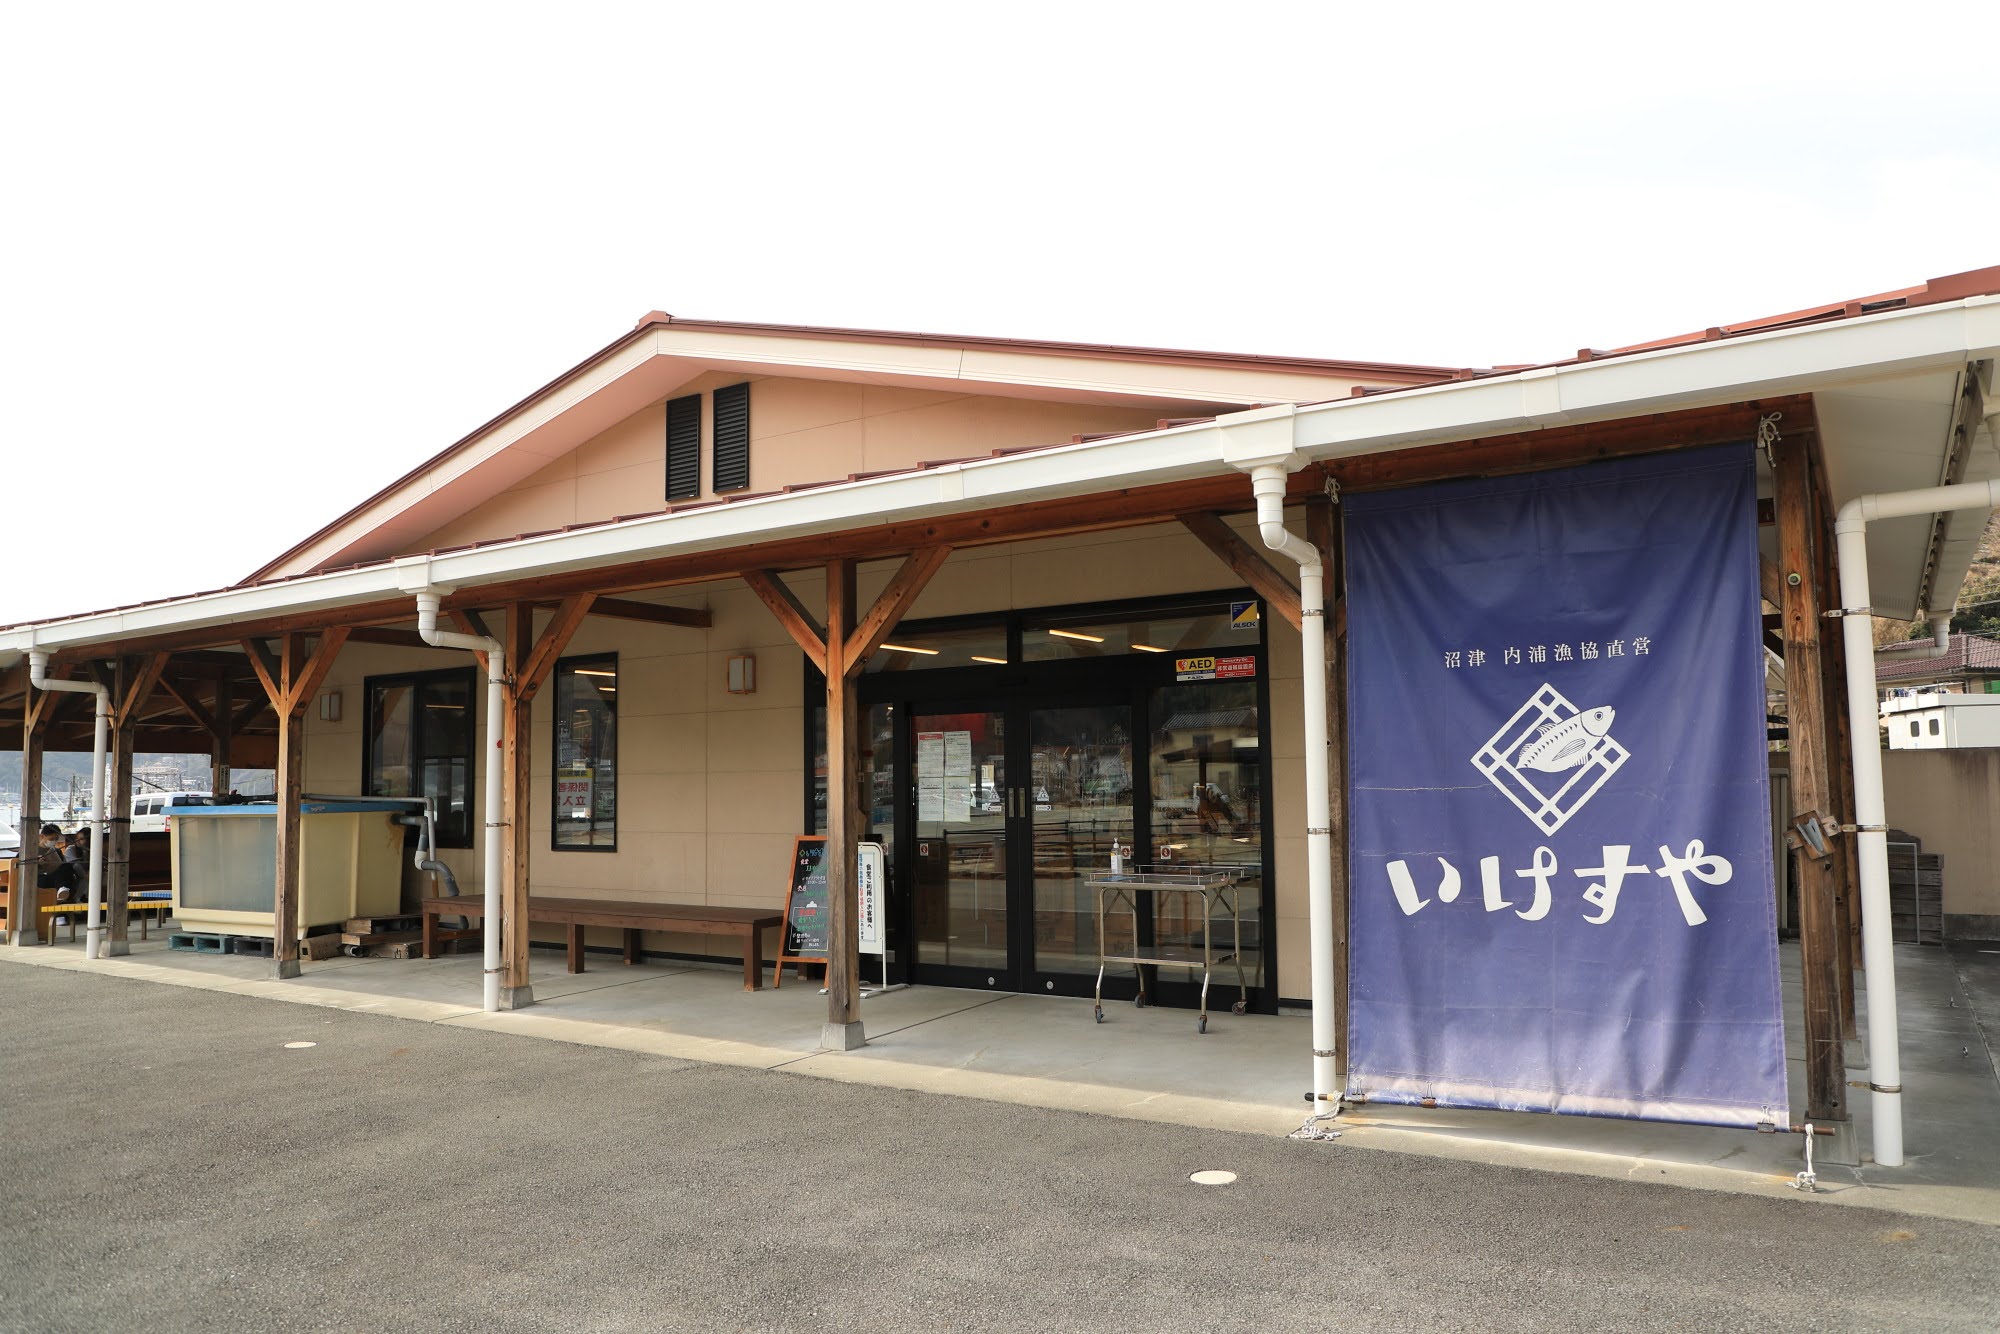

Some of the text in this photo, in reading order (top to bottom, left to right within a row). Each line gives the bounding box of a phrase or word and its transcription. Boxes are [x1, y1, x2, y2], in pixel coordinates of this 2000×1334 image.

[1189, 660, 1212, 670] AED
[1445, 637, 1651, 669] 沼津 内浦漁協直営
[1386, 839, 1733, 926] いけすや
